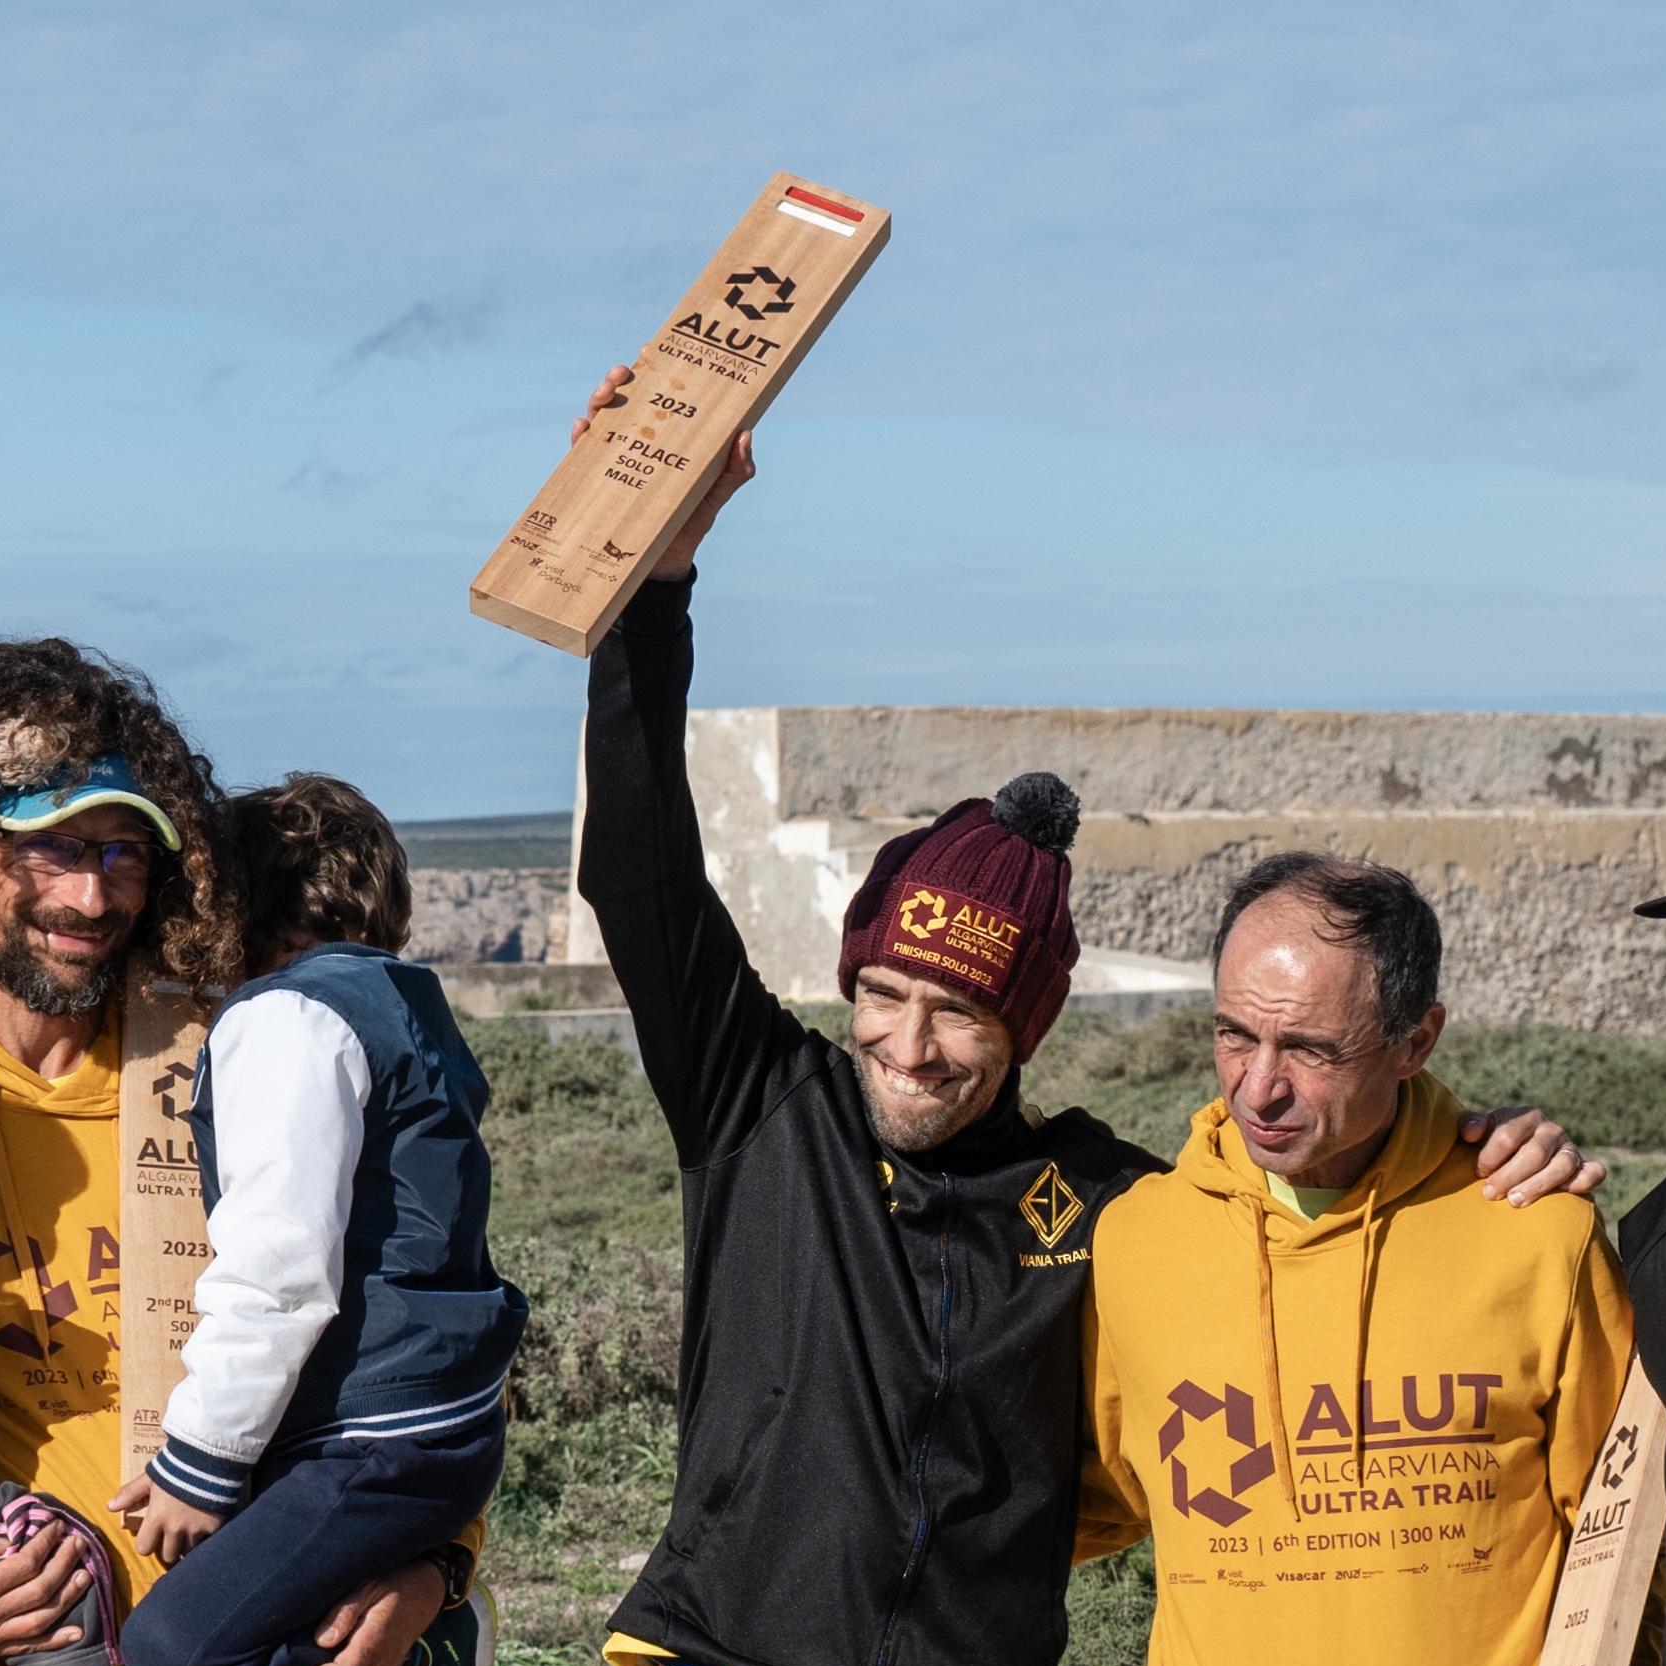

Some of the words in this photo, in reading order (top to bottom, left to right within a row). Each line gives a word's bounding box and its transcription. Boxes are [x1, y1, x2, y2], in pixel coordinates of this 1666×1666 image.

[675, 312, 781, 359] ALUT
[658, 343, 703, 367] ULTRA
[708, 362, 750, 385] TRAIL
[665, 334, 759, 376] ALGARVIANA
[649, 393, 697, 419] 2023
[606, 431, 629, 444] 1st
[629, 440, 691, 471] PLACE
[615, 454, 655, 476] SOLO
[604, 467, 647, 490] MALE
[953, 904, 1021, 944] ALUT
[893, 942, 941, 964] FINISHER
[941, 956, 969, 974] SOLO
[945, 936, 978, 955] ULTRA
[980, 949, 1006, 969] TRAIL
[948, 926, 1010, 959] ALGARVIANA
[137, 1183, 185, 1197] ULTRA
[162, 1240, 209, 1258] 2023
[1019, 1252, 1054, 1267] VIANA
[1054, 1248, 1091, 1266] TRAIL
[146, 1298, 172, 1312] 2nd
[23, 1368, 69, 1386] 2023
[1296, 1373, 1503, 1441] ALUT
[1300, 1448, 1501, 1486] ALGARVIANA
[1301, 1487, 1404, 1516] ULTRA
[1412, 1479, 1496, 1506] TRAIL
[1577, 1498, 1631, 1538] ALUT
[1208, 1537, 1249, 1554] 2023
[1273, 1533, 1300, 1552] 6th
[1306, 1531, 1381, 1551] EDITION
[1400, 1526, 1434, 1545] 300
[1439, 1523, 1467, 1540] KM
[1568, 1556, 1592, 1572] ULTRA
[1593, 1548, 1615, 1563] TRAIL
[1564, 1608, 1589, 1629] 2023
